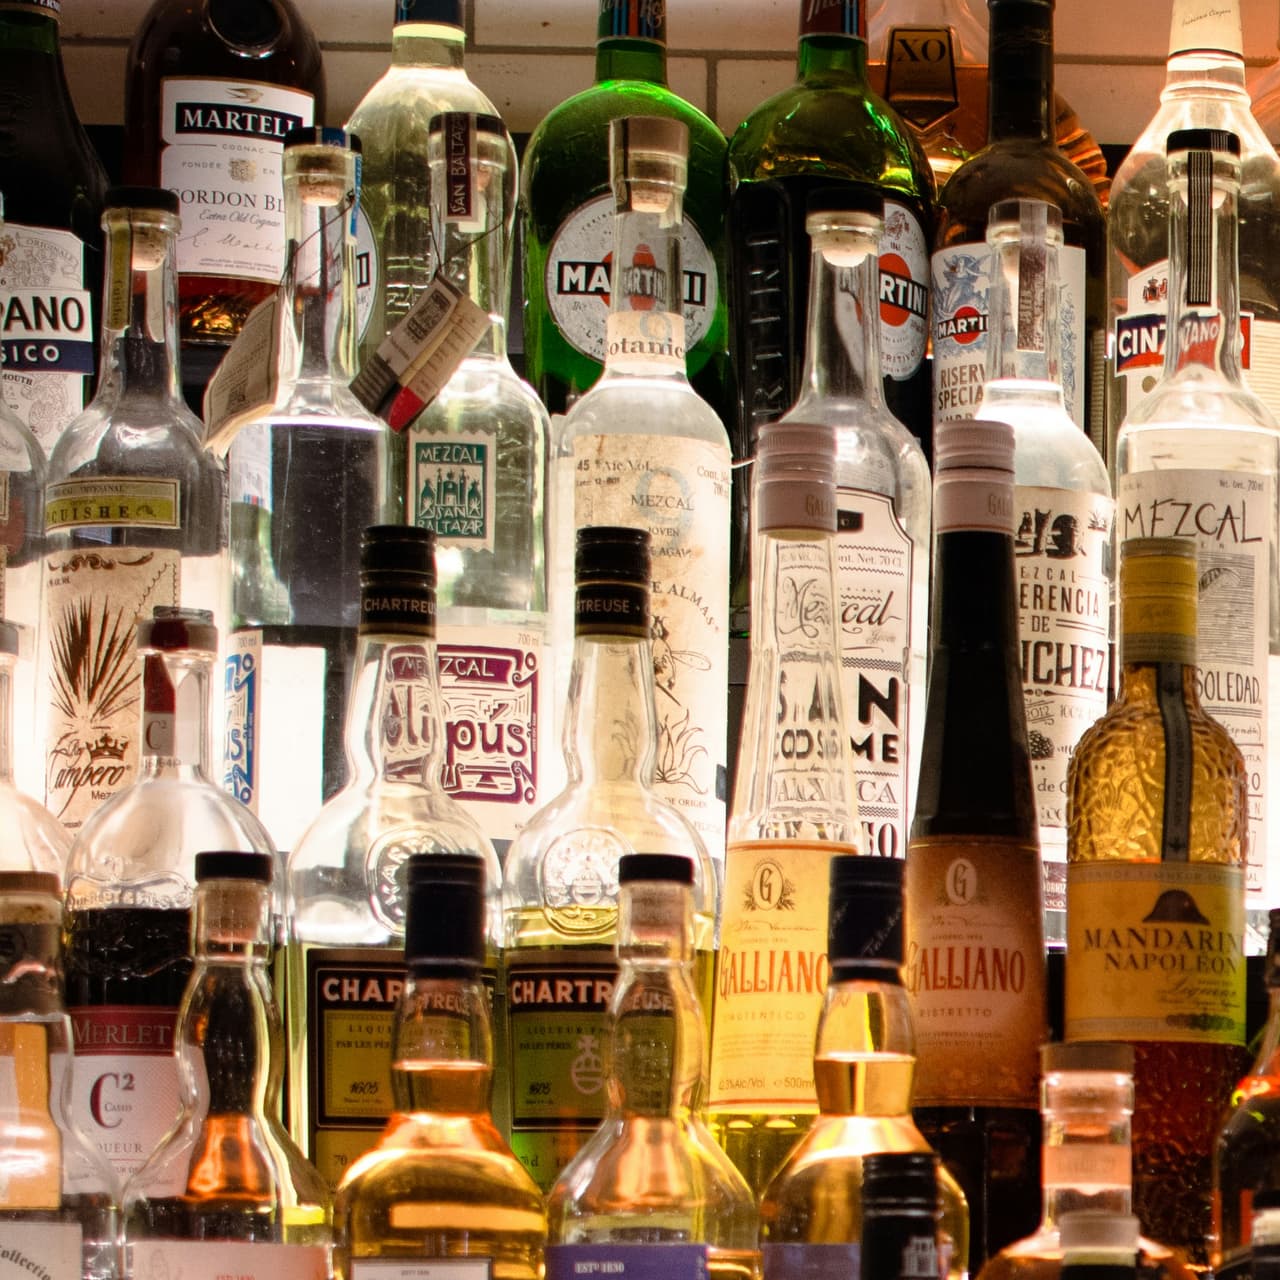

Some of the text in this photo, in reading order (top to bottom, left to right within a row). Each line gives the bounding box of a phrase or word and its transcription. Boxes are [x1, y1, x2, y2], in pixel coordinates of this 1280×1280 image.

[897, 38, 947, 63] XO
[221, 143, 264, 154] COGNAC
[263, 167, 275, 175] EN
[169, 187, 257, 208] CORDON
[199, 209, 248, 222] Extra Old
[419, 443, 483, 463] MEZCAL
[433, 504, 466, 519] SAN
[631, 493, 694, 511] MEZCAL
[416, 518, 484, 537] BALTAZAR
[1125, 499, 1262, 543] MEZCAL
[1018, 583, 1100, 618] ERENCIA
[1031, 616, 1051, 632] DE
[905, 947, 1025, 996] GALLIANO
[73, 1022, 172, 1048] MERLET
